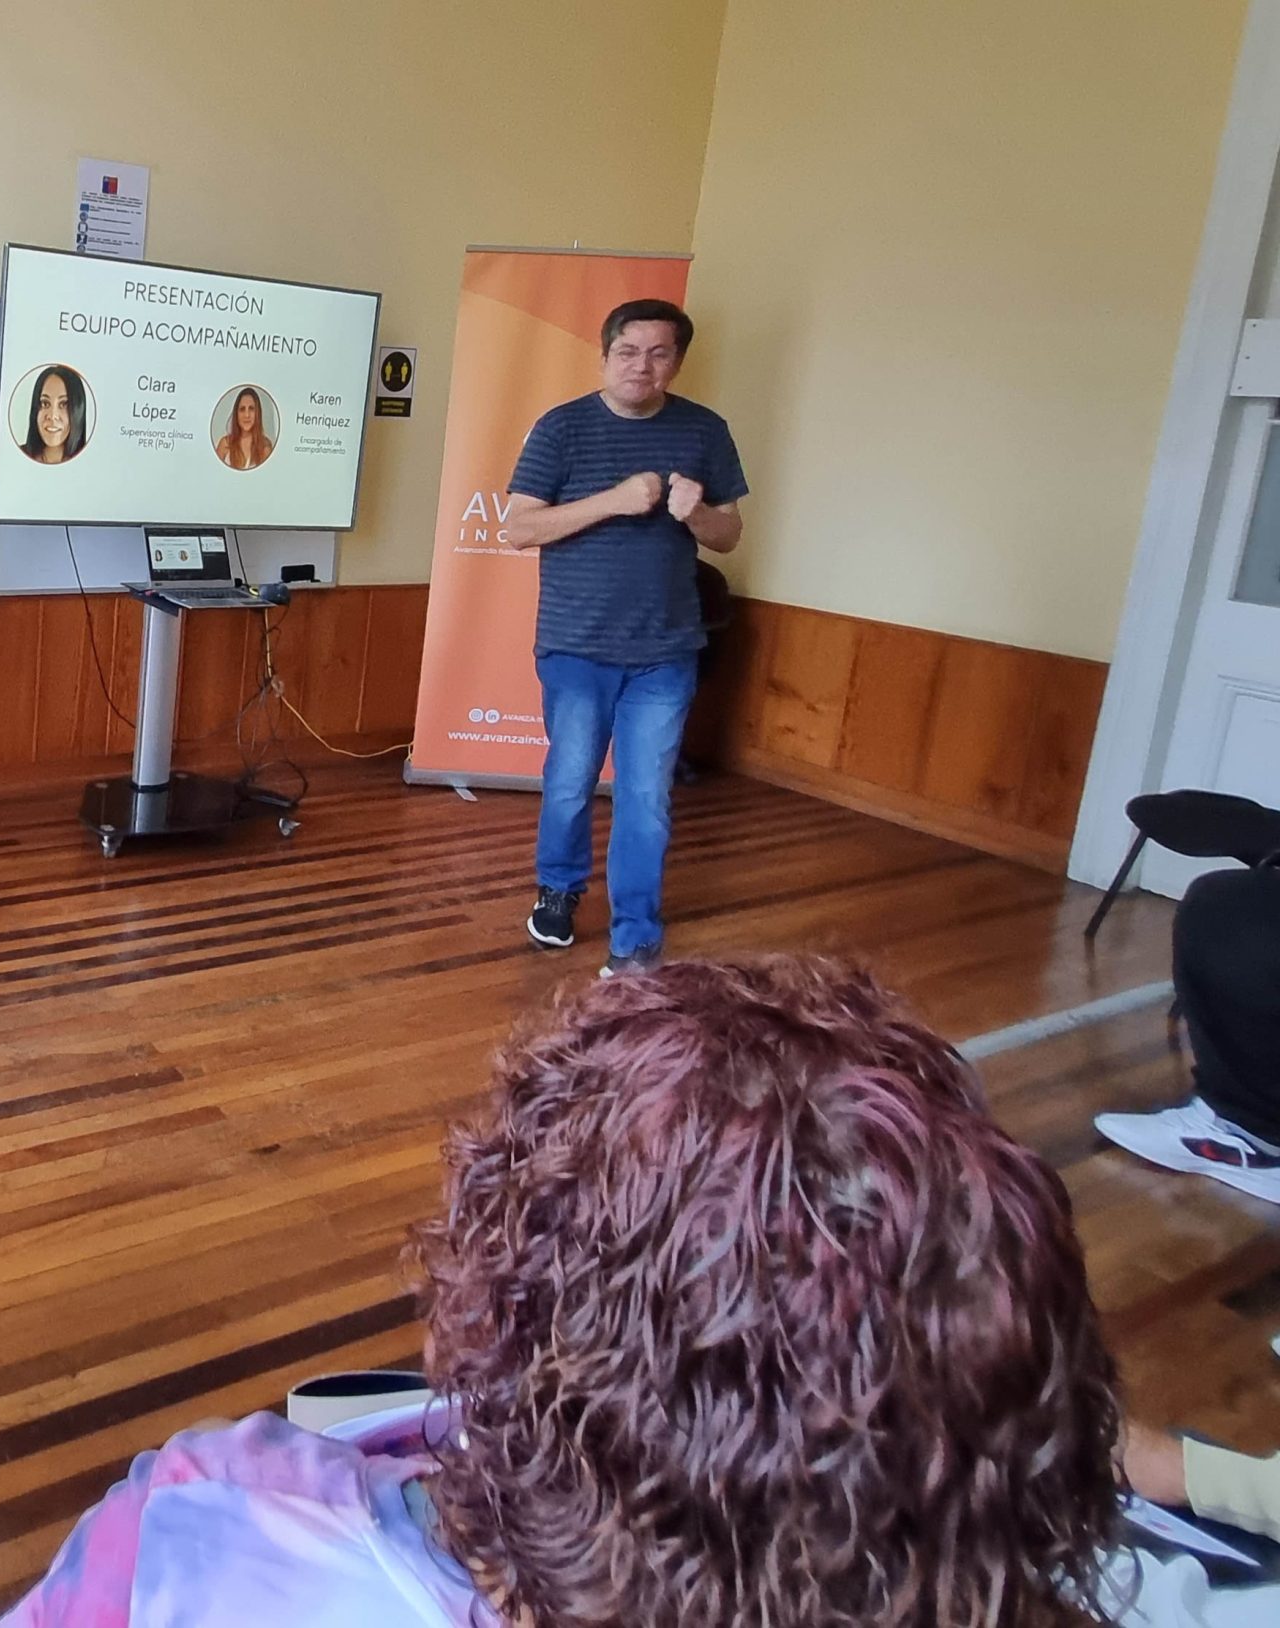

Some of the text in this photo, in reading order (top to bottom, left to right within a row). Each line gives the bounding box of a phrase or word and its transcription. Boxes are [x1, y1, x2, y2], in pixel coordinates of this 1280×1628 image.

[124, 281, 264, 316] PRESENTACIÓN
[59, 312, 317, 357] EQUIPO ACOMPAÑAMIENTO
[137, 375, 176, 393] Clara
[310, 391, 342, 407] Karen
[132, 402, 177, 422] López
[296, 411, 351, 430] Henriquez
[120, 425, 194, 440] Supervisora clínica
[138, 437, 175, 453] PER (Par)
[461, 491, 513, 523] AV
[459, 528, 508, 543] INC
